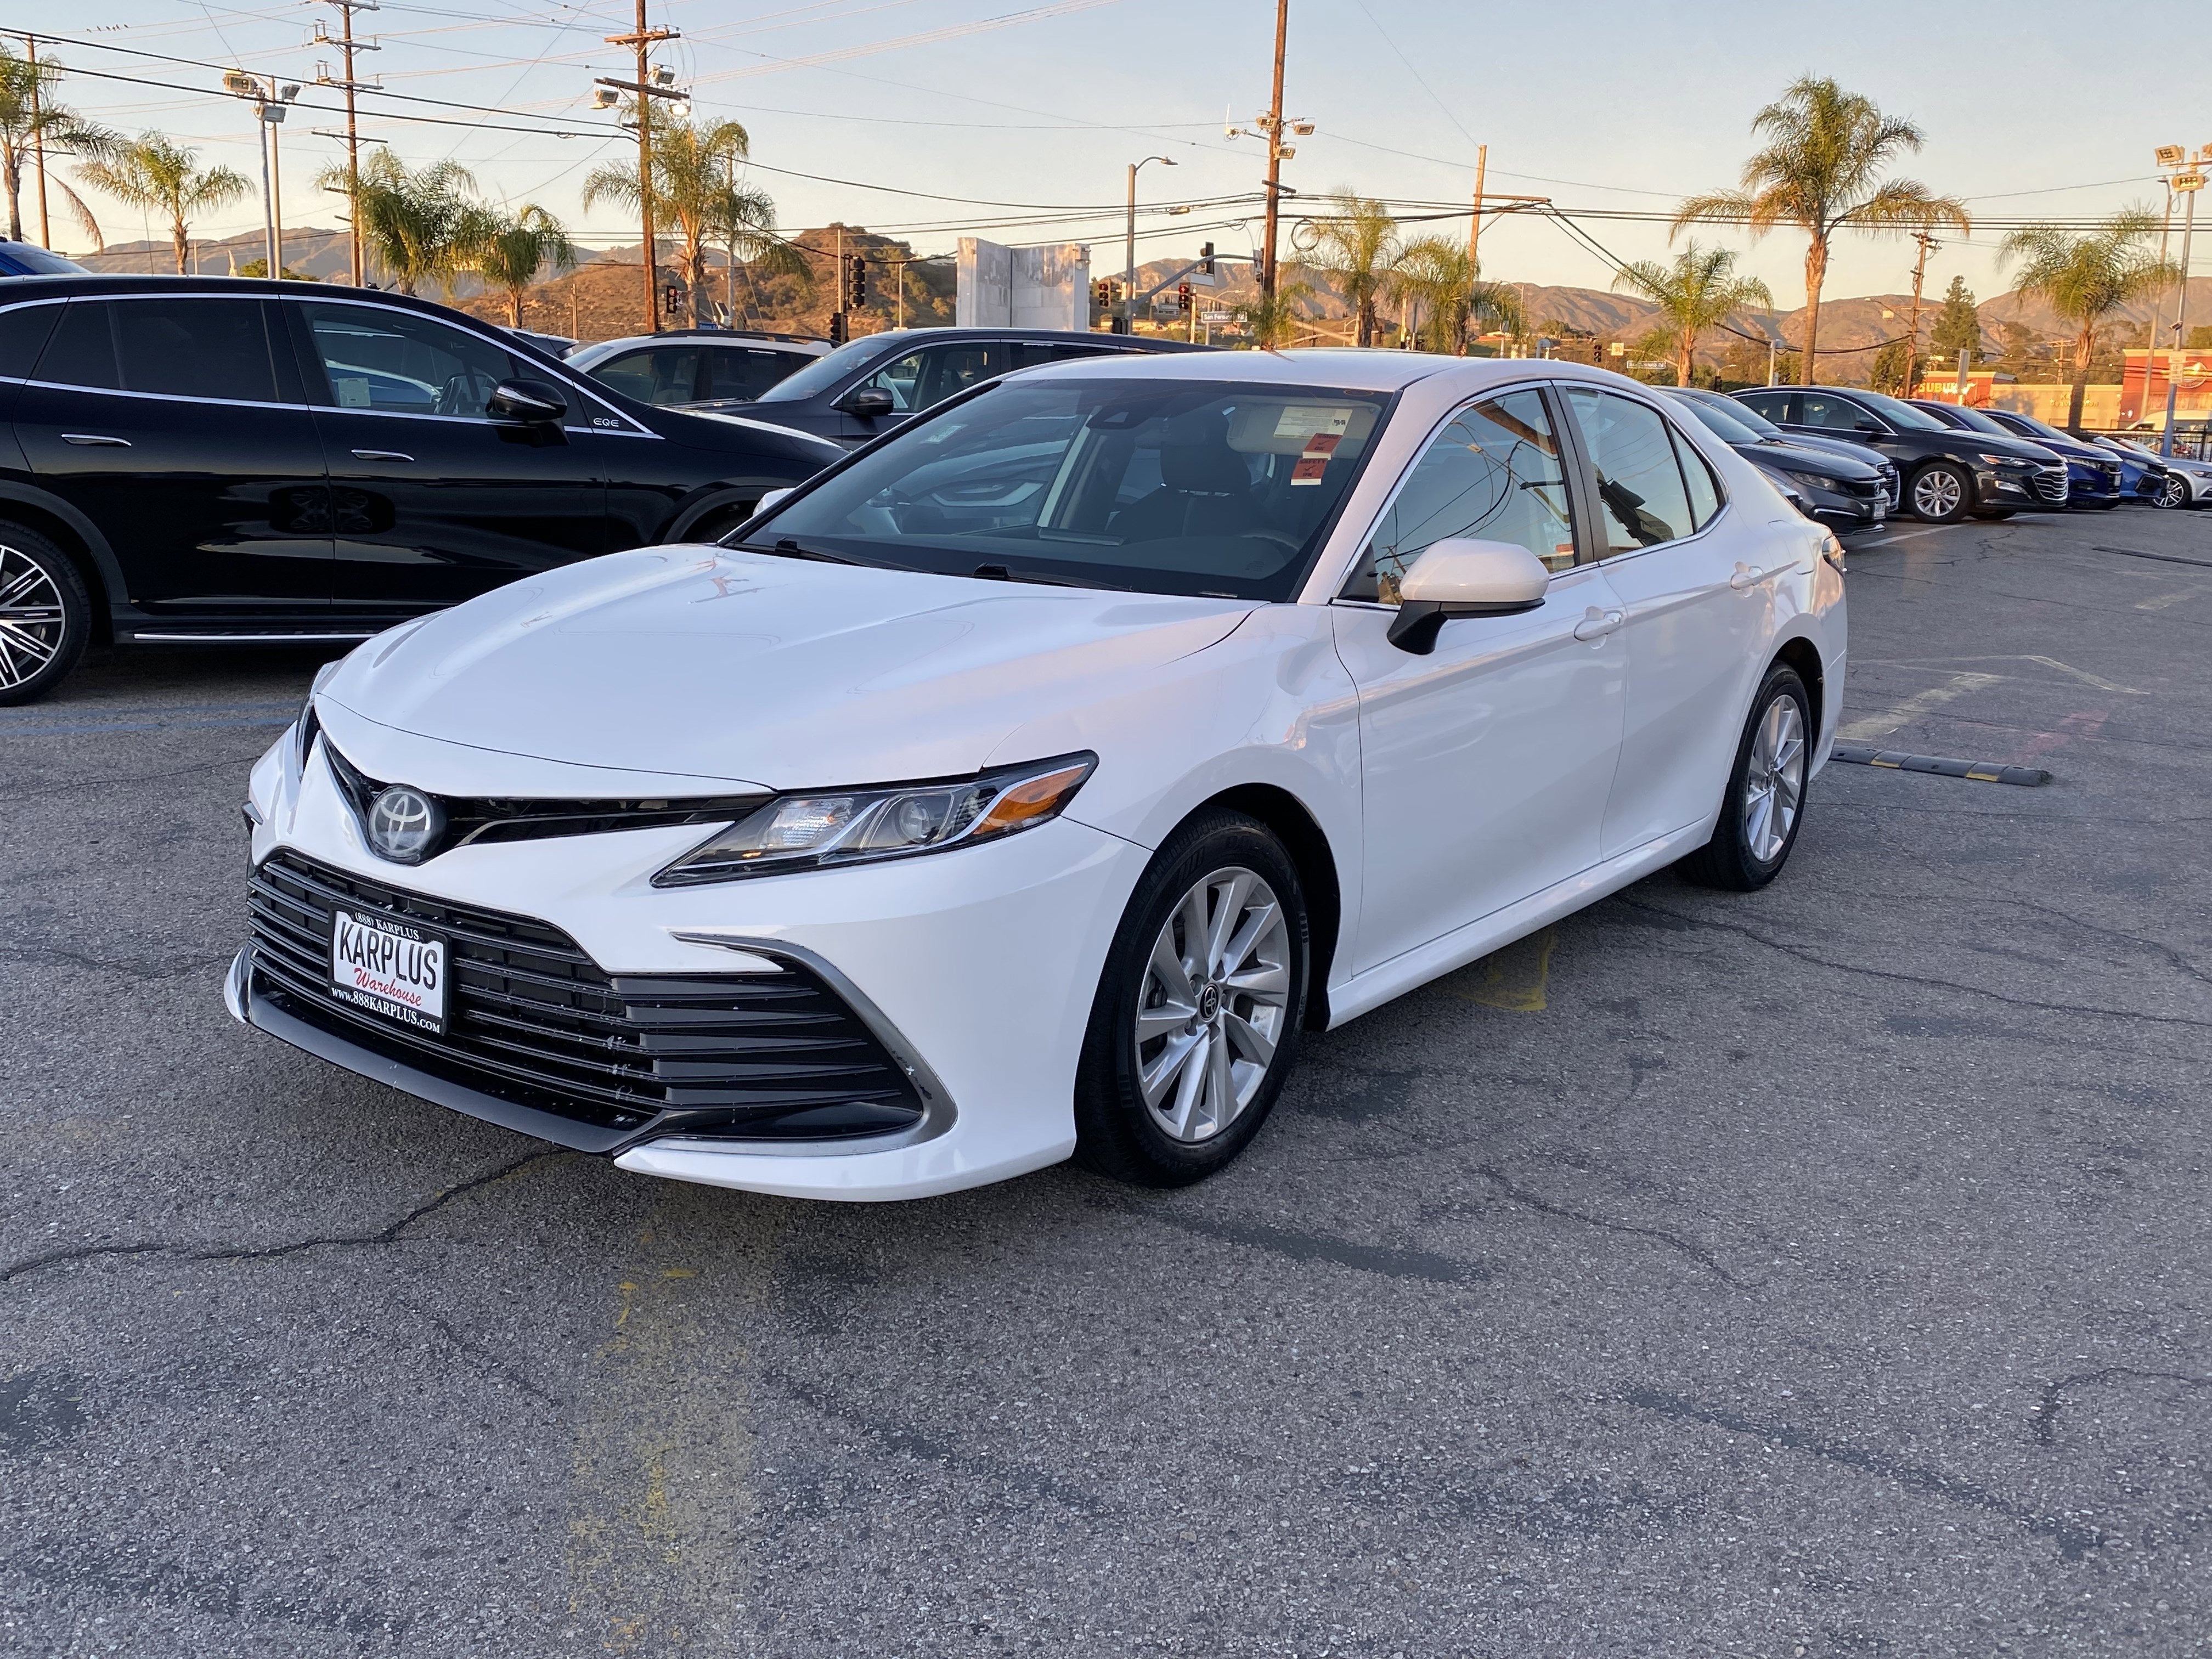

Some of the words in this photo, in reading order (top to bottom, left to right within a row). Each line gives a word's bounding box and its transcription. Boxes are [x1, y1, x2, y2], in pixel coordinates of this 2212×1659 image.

[593, 417, 619, 427] EQE
[355, 911, 374, 927] (888)
[375, 918, 420, 940] KARPLUS
[339, 921, 438, 991] KARPLUS
[353, 967, 422, 1007] Warehouse
